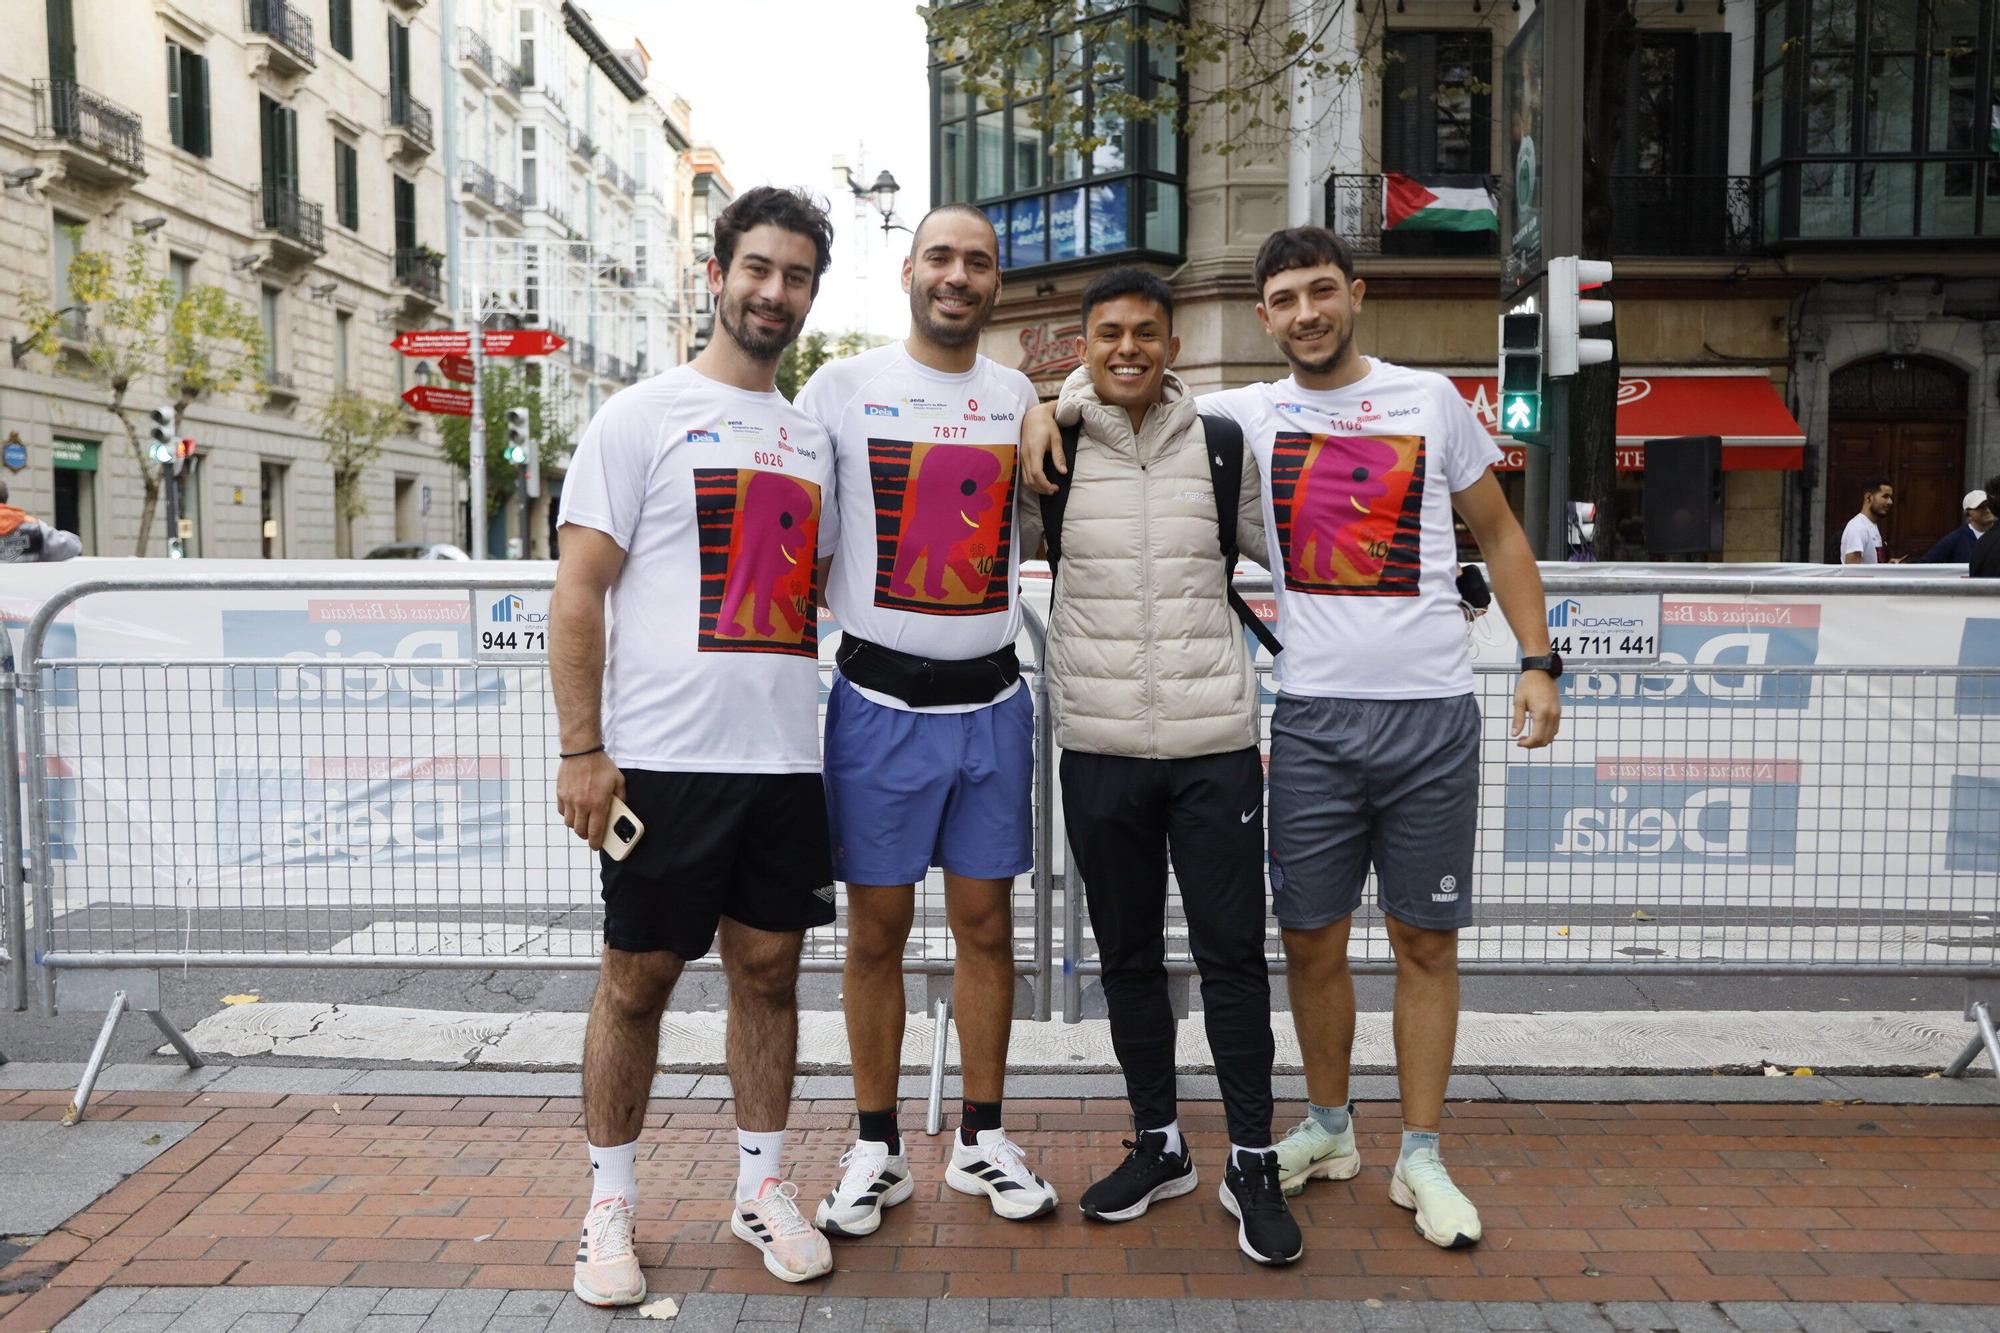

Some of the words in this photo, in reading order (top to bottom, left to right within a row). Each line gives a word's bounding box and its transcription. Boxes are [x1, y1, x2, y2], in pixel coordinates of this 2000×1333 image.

[870, 408, 893, 417] Deia
[963, 413, 986, 422] Bilbao
[933, 426, 968, 439] 7877
[754, 451, 784, 467] 6026
[1367, 541, 1389, 558] 10
[977, 555, 994, 574] 10
[516, 613, 549, 622] INDA
[482, 631, 517, 650] 944
[524, 631, 545, 650] 71
[1551, 637, 1572, 654] 44
[1579, 636, 1611, 654] 711
[1620, 636, 1653, 654] 441
